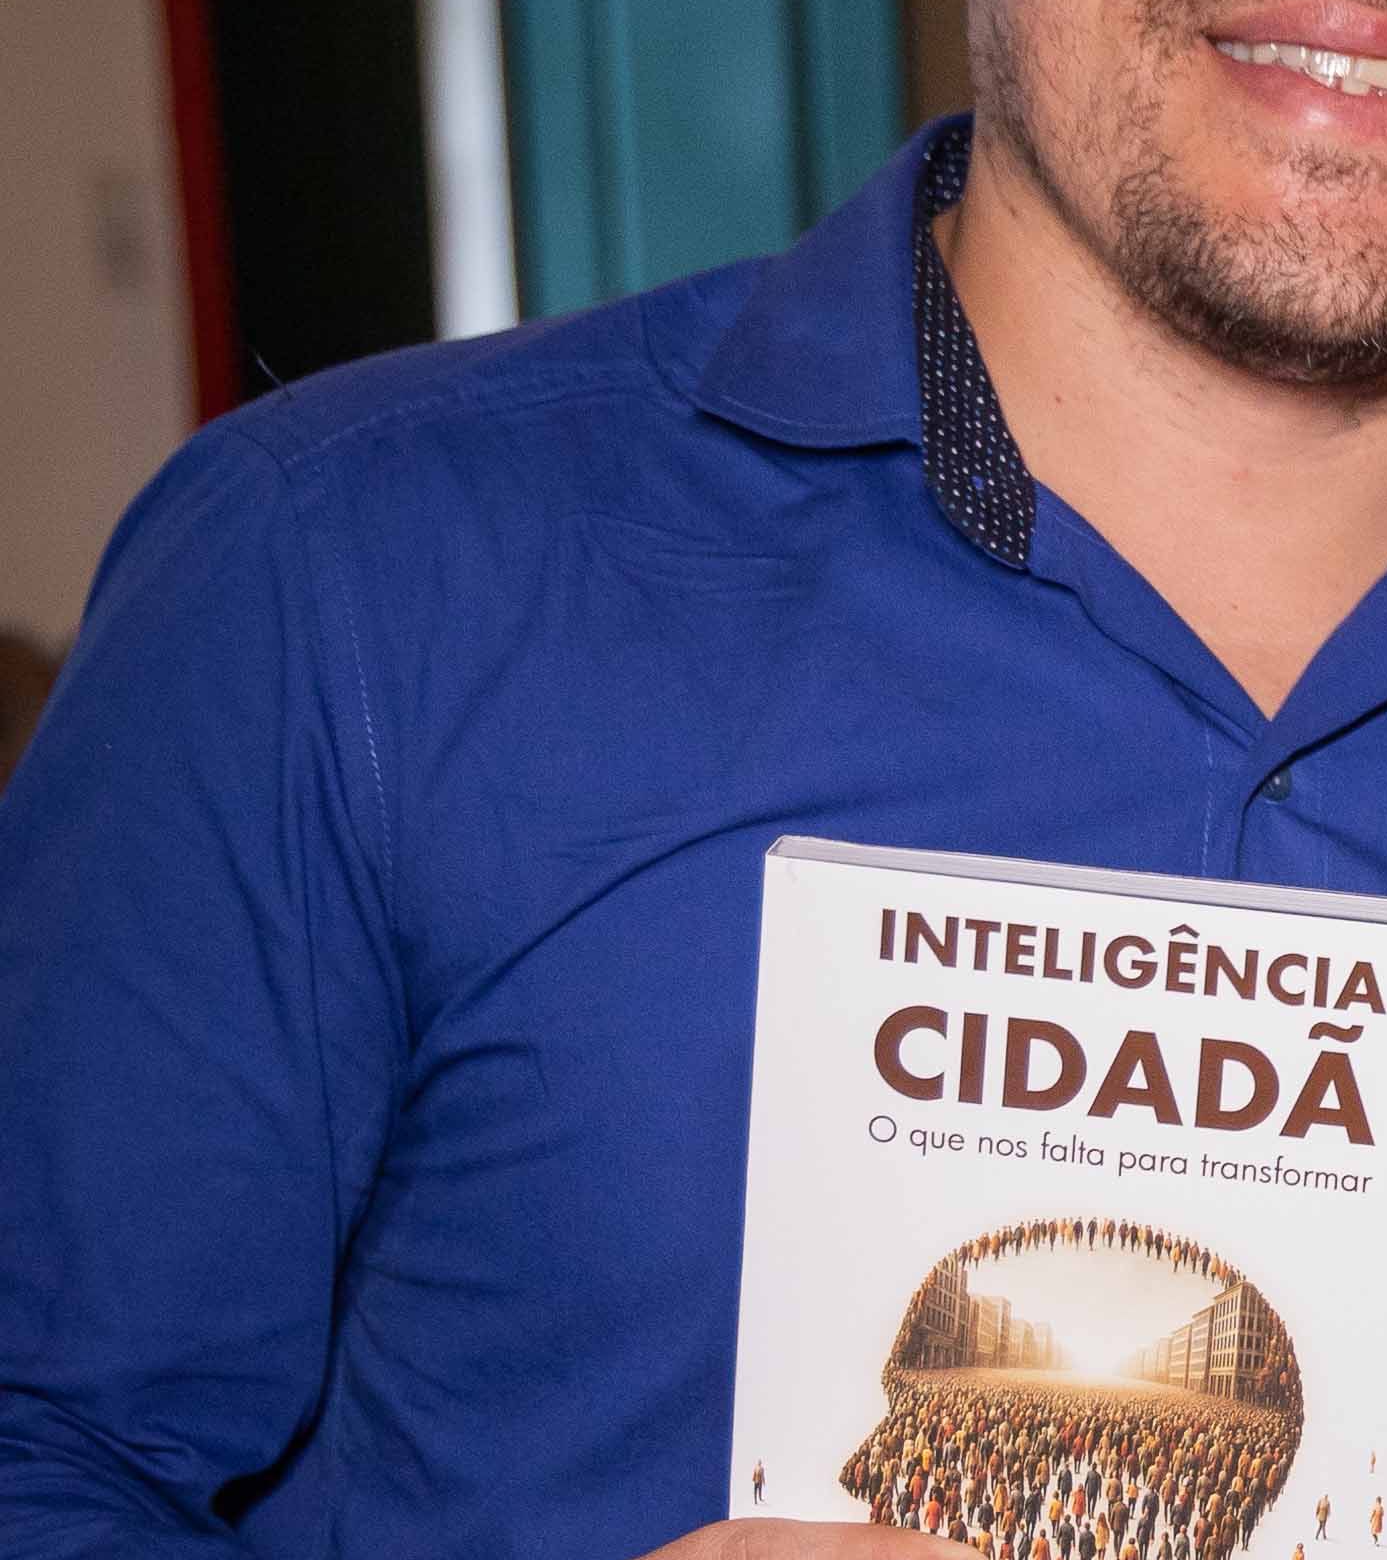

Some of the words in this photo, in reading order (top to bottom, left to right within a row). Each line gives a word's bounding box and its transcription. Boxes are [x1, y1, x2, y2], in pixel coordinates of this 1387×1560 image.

[880, 908, 1387, 1015] INTELIGÊNCIA
[873, 1006, 1376, 1147] CIDADÃ
[868, 1115, 898, 1143] O
[909, 1129, 965, 1156] que
[978, 1136, 1028, 1158] nos
[1040, 1131, 1105, 1166] falta
[1118, 1151, 1188, 1177] para
[1201, 1153, 1373, 1193] transformar
